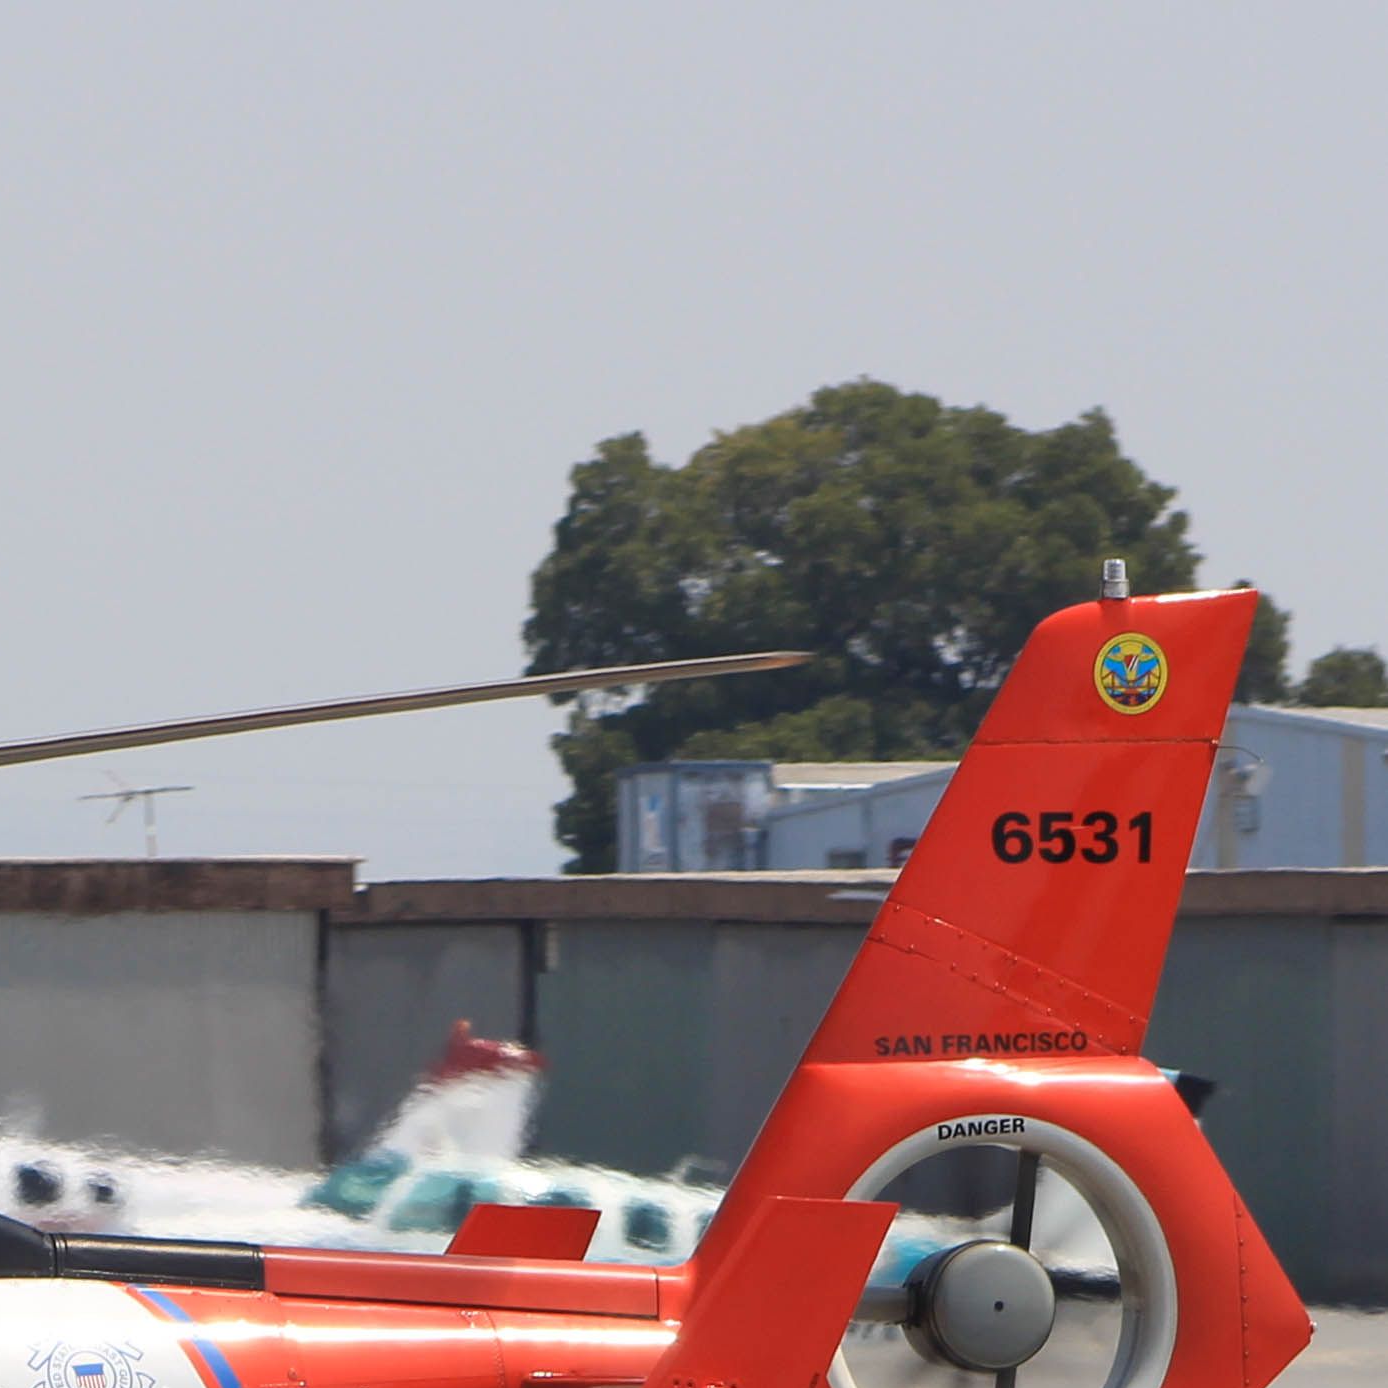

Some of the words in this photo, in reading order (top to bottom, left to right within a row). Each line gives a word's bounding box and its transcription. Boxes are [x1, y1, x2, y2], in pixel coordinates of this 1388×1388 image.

[991, 811, 1152, 864] 6531
[874, 1035, 932, 1056] SAN
[941, 1031, 1089, 1054] FRANCISCO
[937, 1117, 1025, 1140] DANGER
